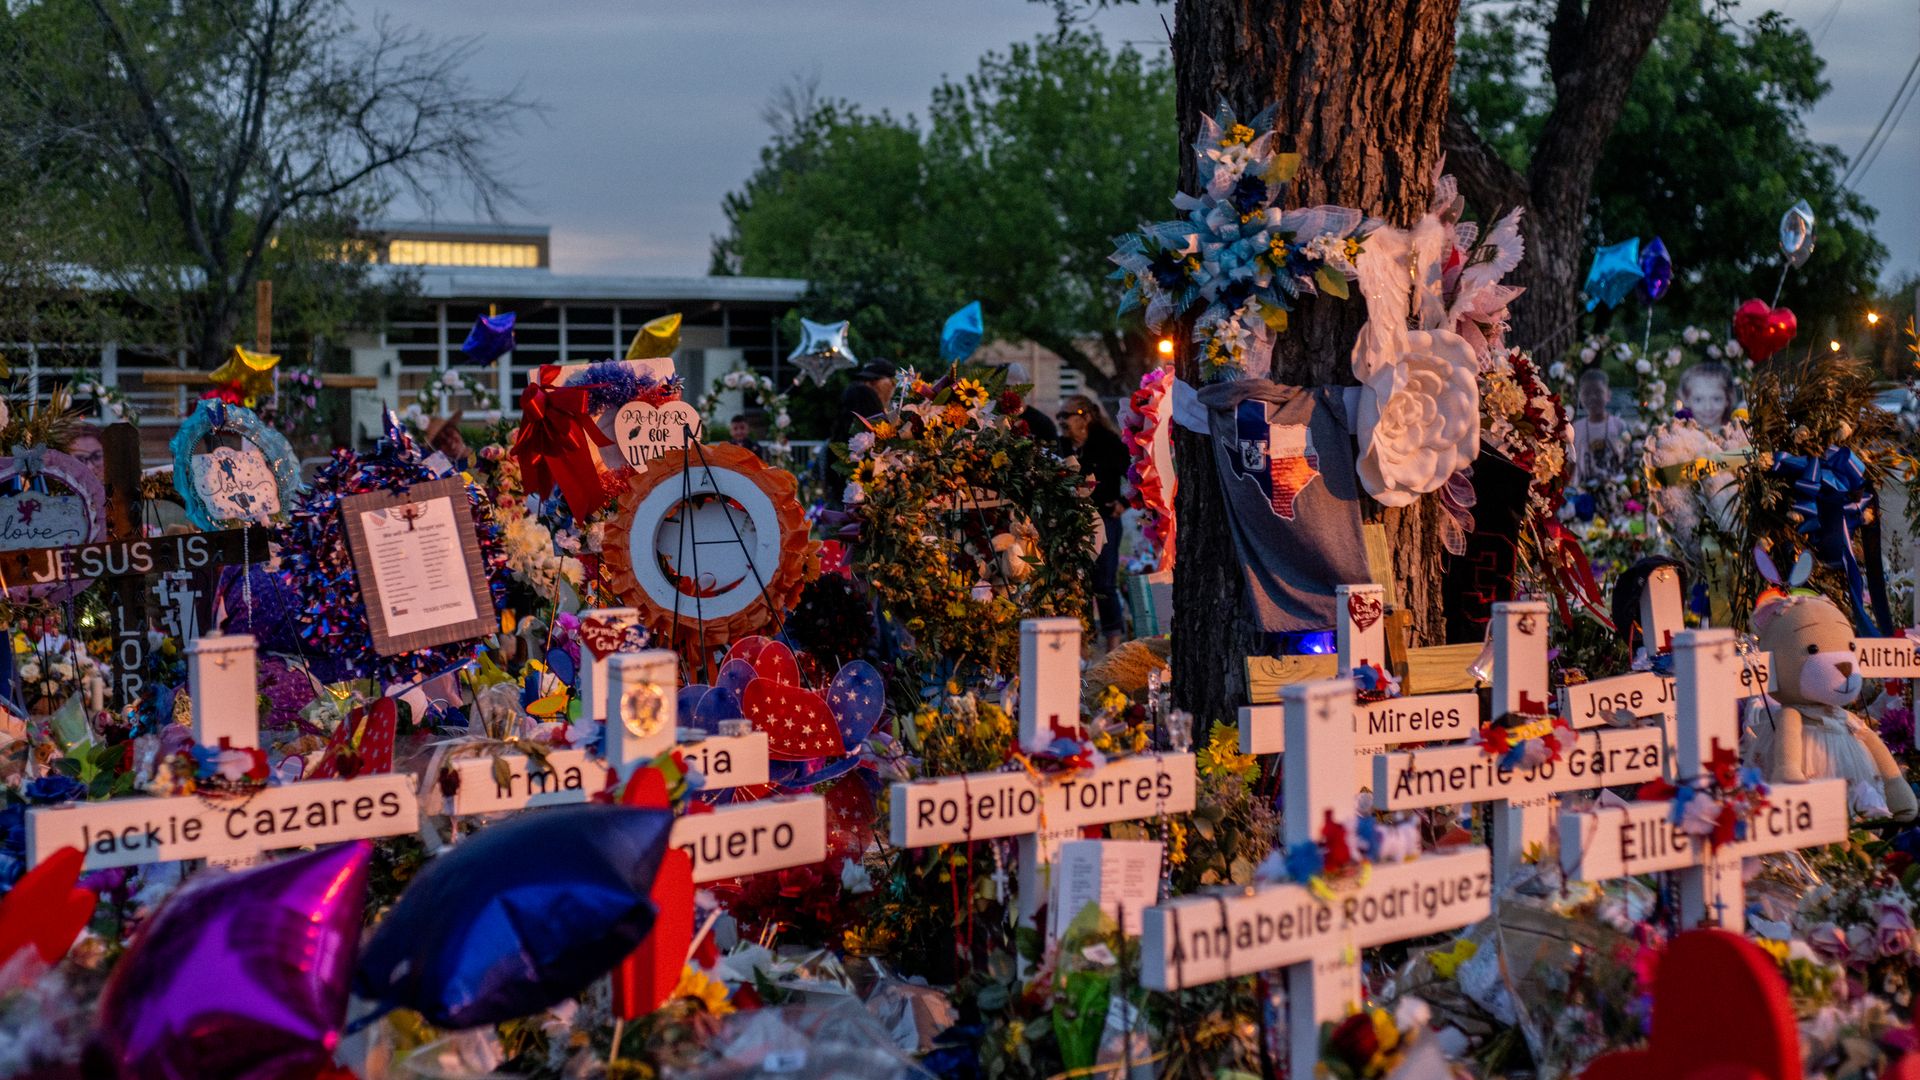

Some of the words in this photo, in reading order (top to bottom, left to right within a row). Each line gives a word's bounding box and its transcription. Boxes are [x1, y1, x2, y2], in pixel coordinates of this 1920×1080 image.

[201, 470, 272, 496] love
[0, 515, 79, 540] love
[33, 541, 153, 583] JESUS
[177, 536, 209, 569] IS
[1369, 708, 1460, 735] Mireles
[1585, 689, 1643, 718] Jose
[1394, 757, 1511, 800] Amerie
[1568, 743, 1660, 777] Garza
[80, 816, 203, 855] Jackie
[225, 791, 401, 839] Cazares
[918, 787, 1036, 834] Rojelio
[1060, 772, 1173, 811] Torres
[1619, 817, 1688, 863] Ellie
[1168, 905, 1332, 966] Annabelle
[1342, 872, 1492, 926] Rodriguez
